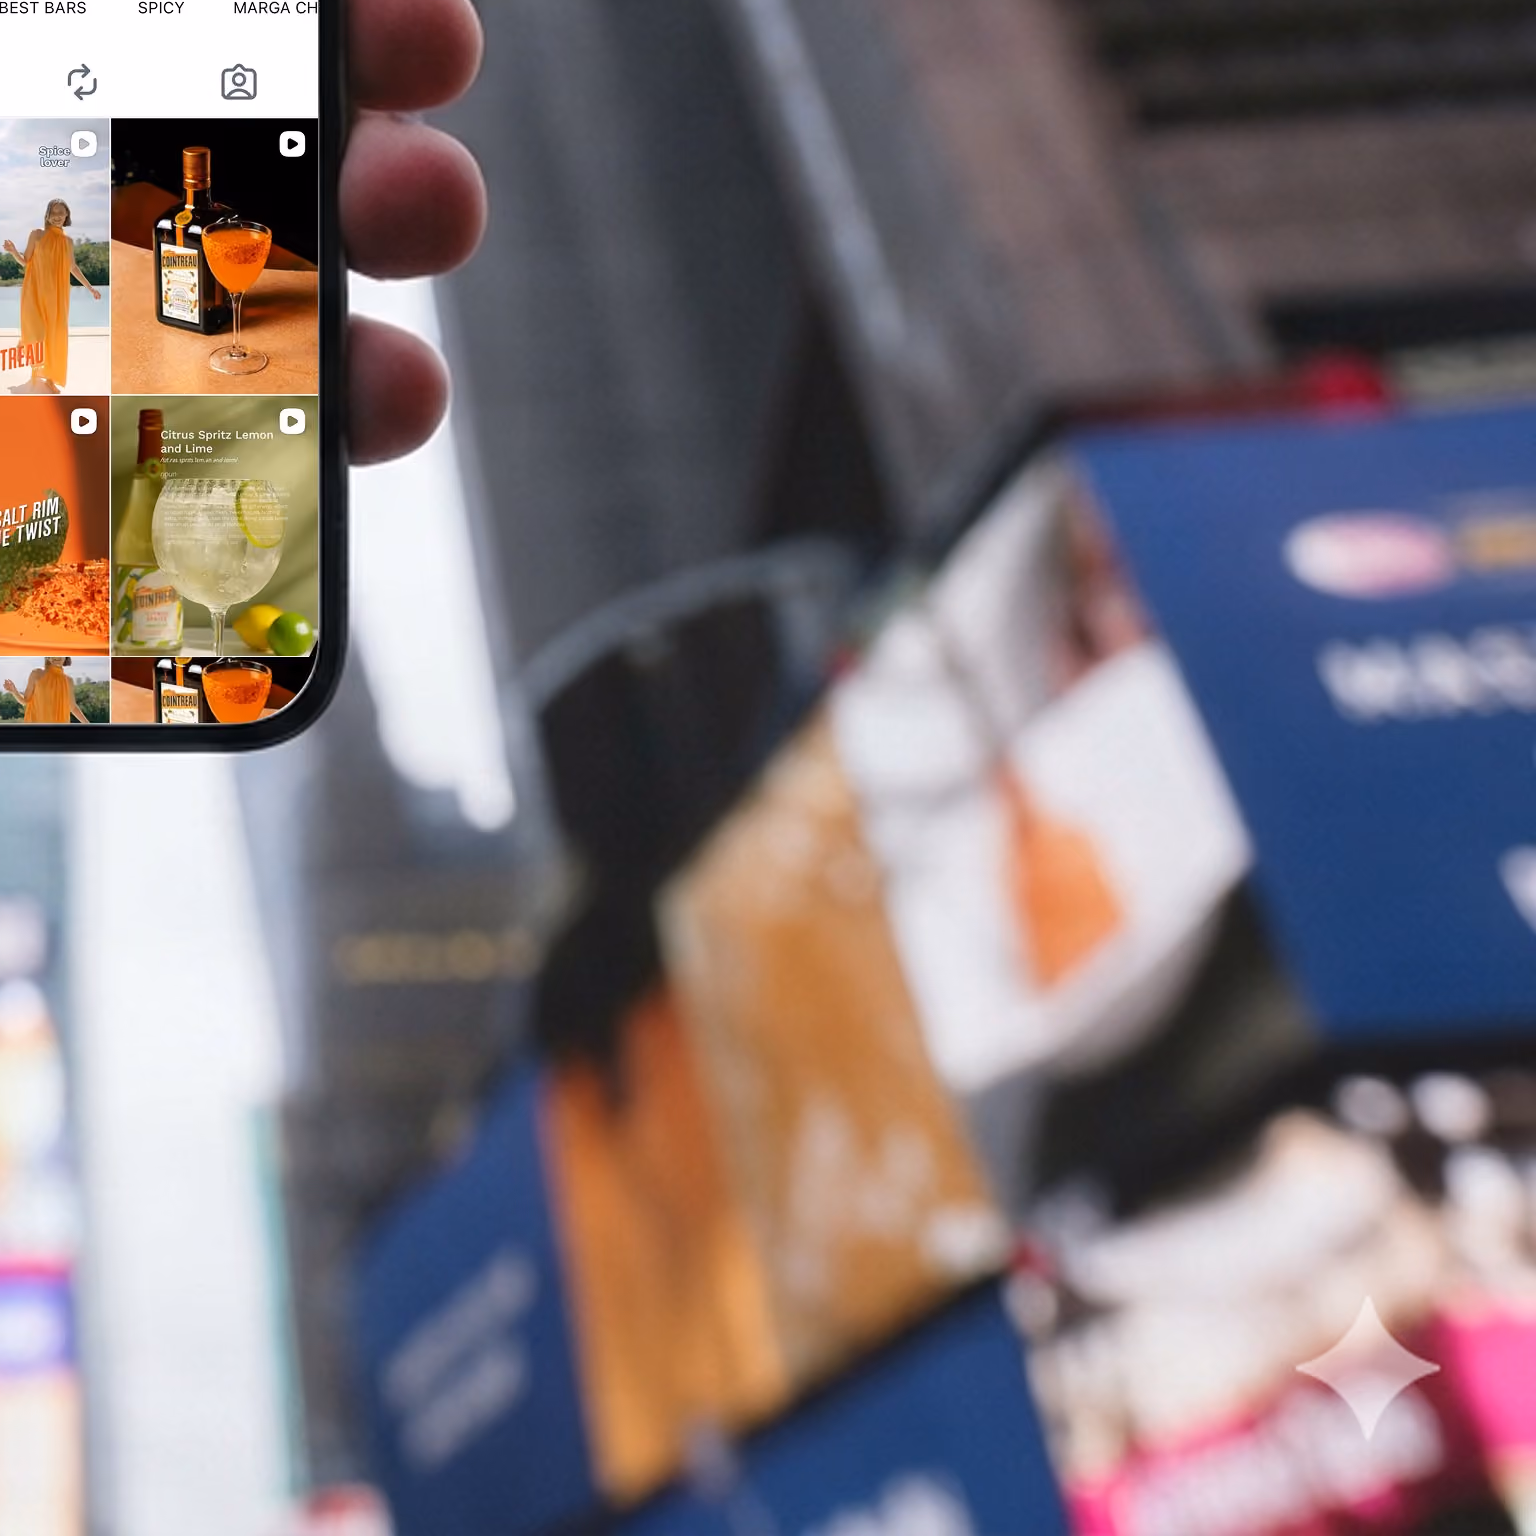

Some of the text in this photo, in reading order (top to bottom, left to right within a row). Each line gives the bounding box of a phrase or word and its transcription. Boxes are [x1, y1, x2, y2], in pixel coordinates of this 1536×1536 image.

[0, 1, 40, 15] BEST
[44, 1, 87, 15] BARS
[138, 1, 185, 15] SPICY
[233, 1, 291, 15] MARGA
[39, 145, 71, 158] Spice
[40, 157, 70, 167] lover
[162, 255, 198, 268] COINTREAU
[160, 430, 274, 442] Citrus Spritz Lemon
[160, 444, 213, 454] and Lime
[32, 496, 60, 520] RIM
[16, 516, 62, 543] TWIST
[162, 695, 198, 707] COINTREAU
